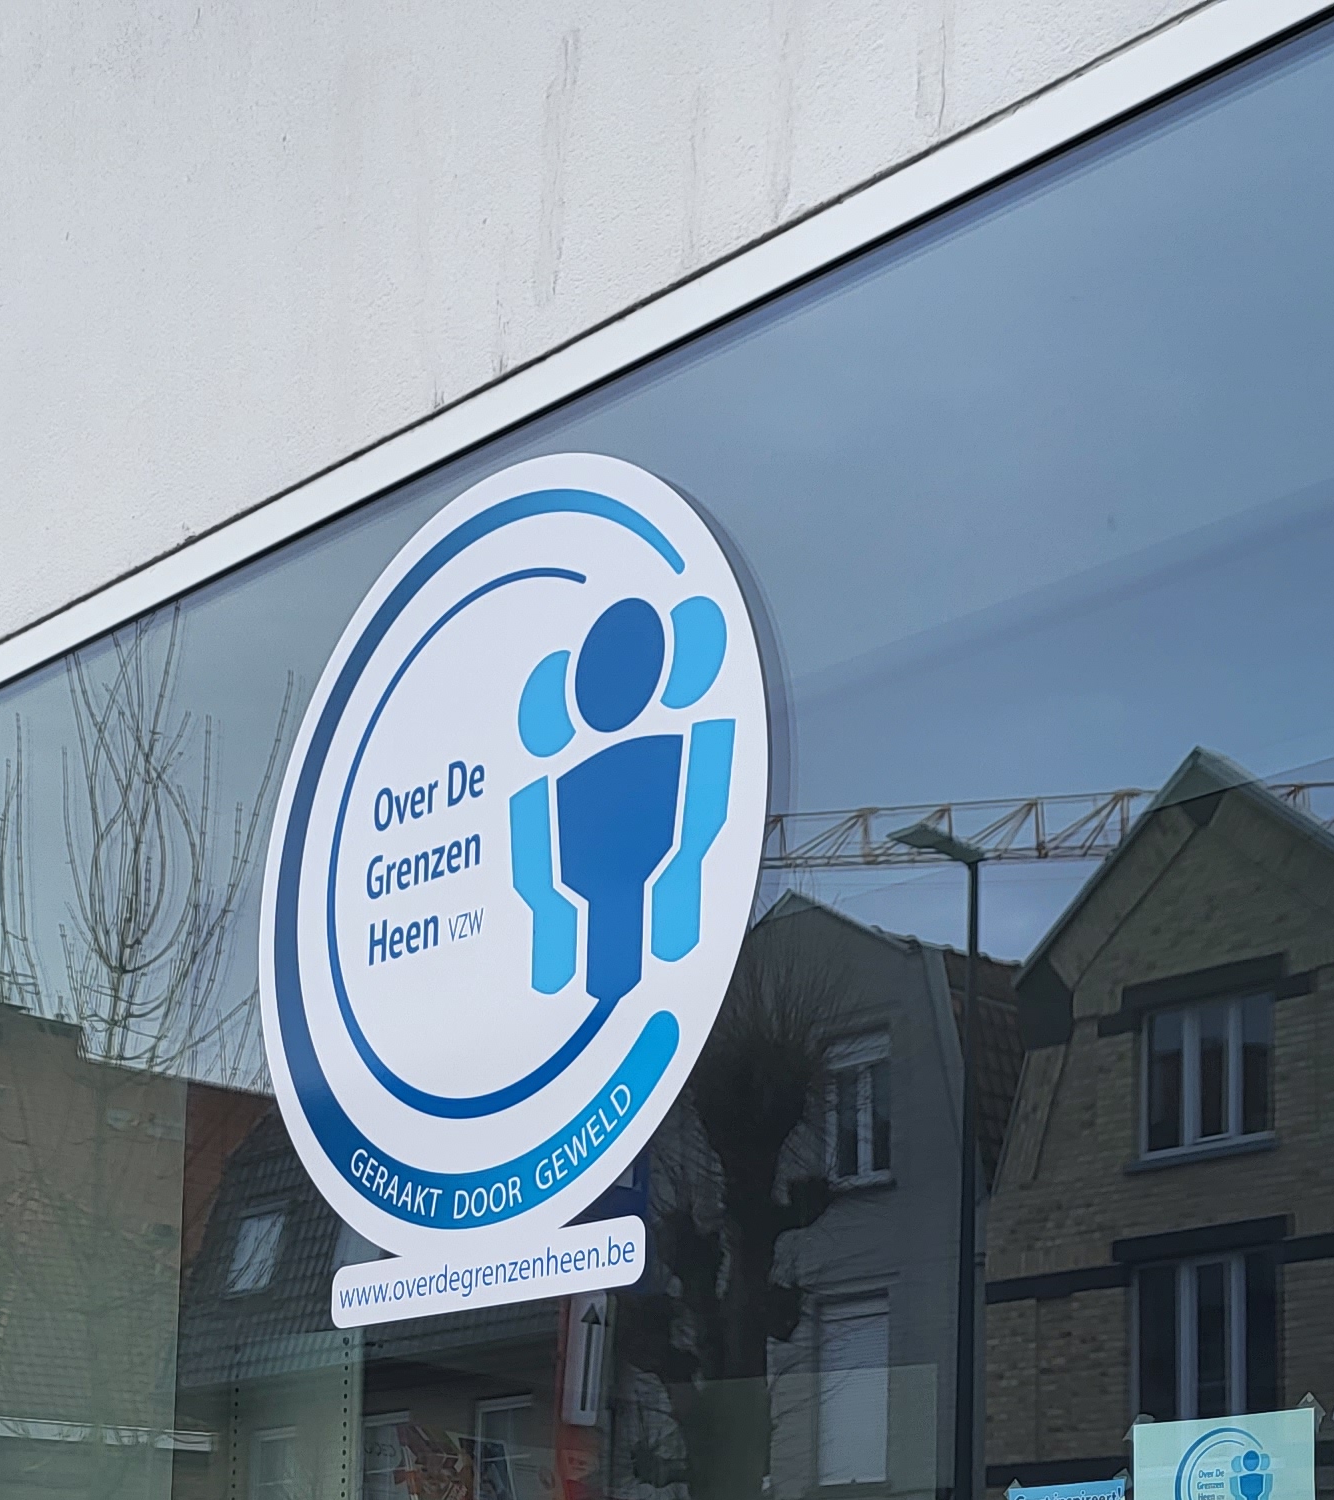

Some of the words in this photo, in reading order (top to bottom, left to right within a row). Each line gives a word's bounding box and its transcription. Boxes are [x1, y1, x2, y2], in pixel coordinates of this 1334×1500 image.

[374, 780, 438, 831] Over
[448, 760, 485, 808] De
[367, 834, 481, 900] Grenzen
[368, 915, 439, 966] Heen
[449, 908, 483, 942] VZW
[351, 1149, 442, 1217] GERAAKT
[453, 1176, 523, 1219] DOOR
[535, 1084, 631, 1190] GEWELD
[339, 1235, 635, 1309] www.overdegrenzenheen.be
[1198, 1470, 1213, 1478] Over
[1216, 1469, 1224, 1477] De
[1198, 1493, 1215, 1500] Heen
